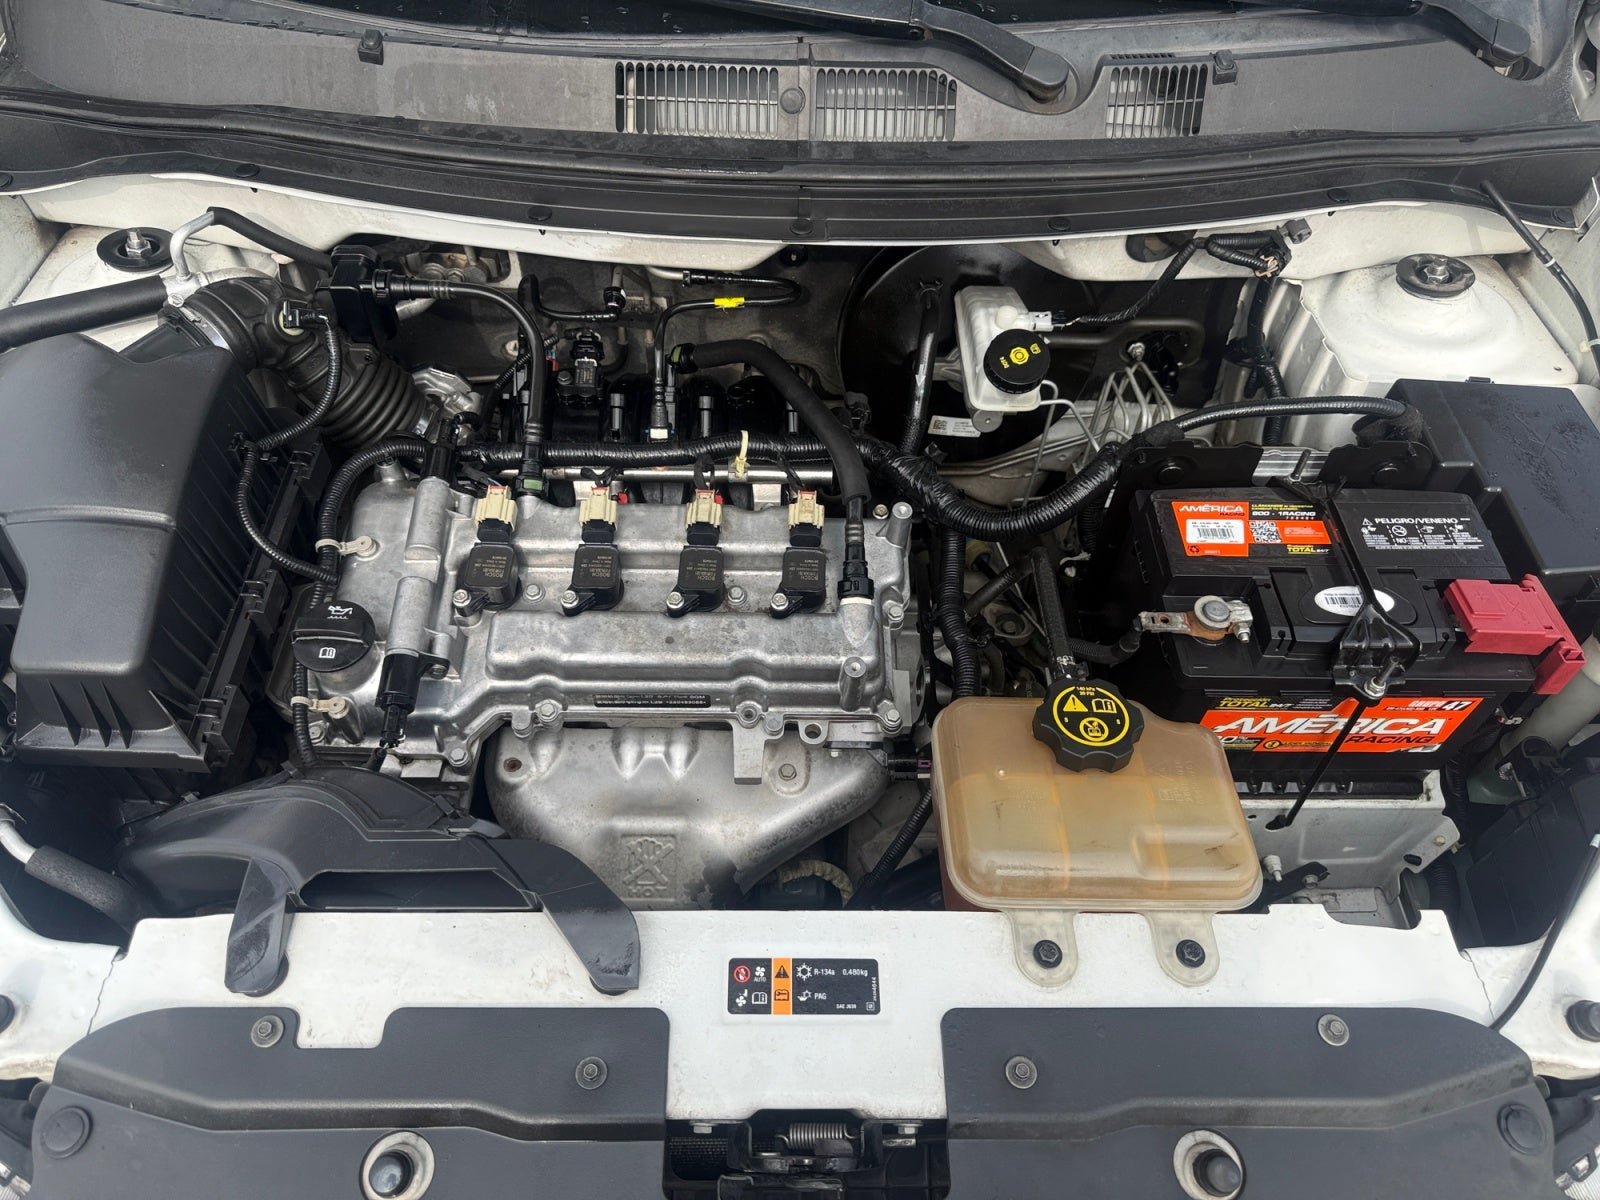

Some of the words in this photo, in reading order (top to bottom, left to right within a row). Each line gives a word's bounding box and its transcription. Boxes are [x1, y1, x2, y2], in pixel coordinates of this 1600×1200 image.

[1179, 504, 1244, 512] AMÉRICA
[1442, 701, 1473, 711] 47
[1213, 714, 1448, 734] AMÉRICA
[813, 968, 836, 976] R-134a
[814, 992, 827, 1000] PAG
